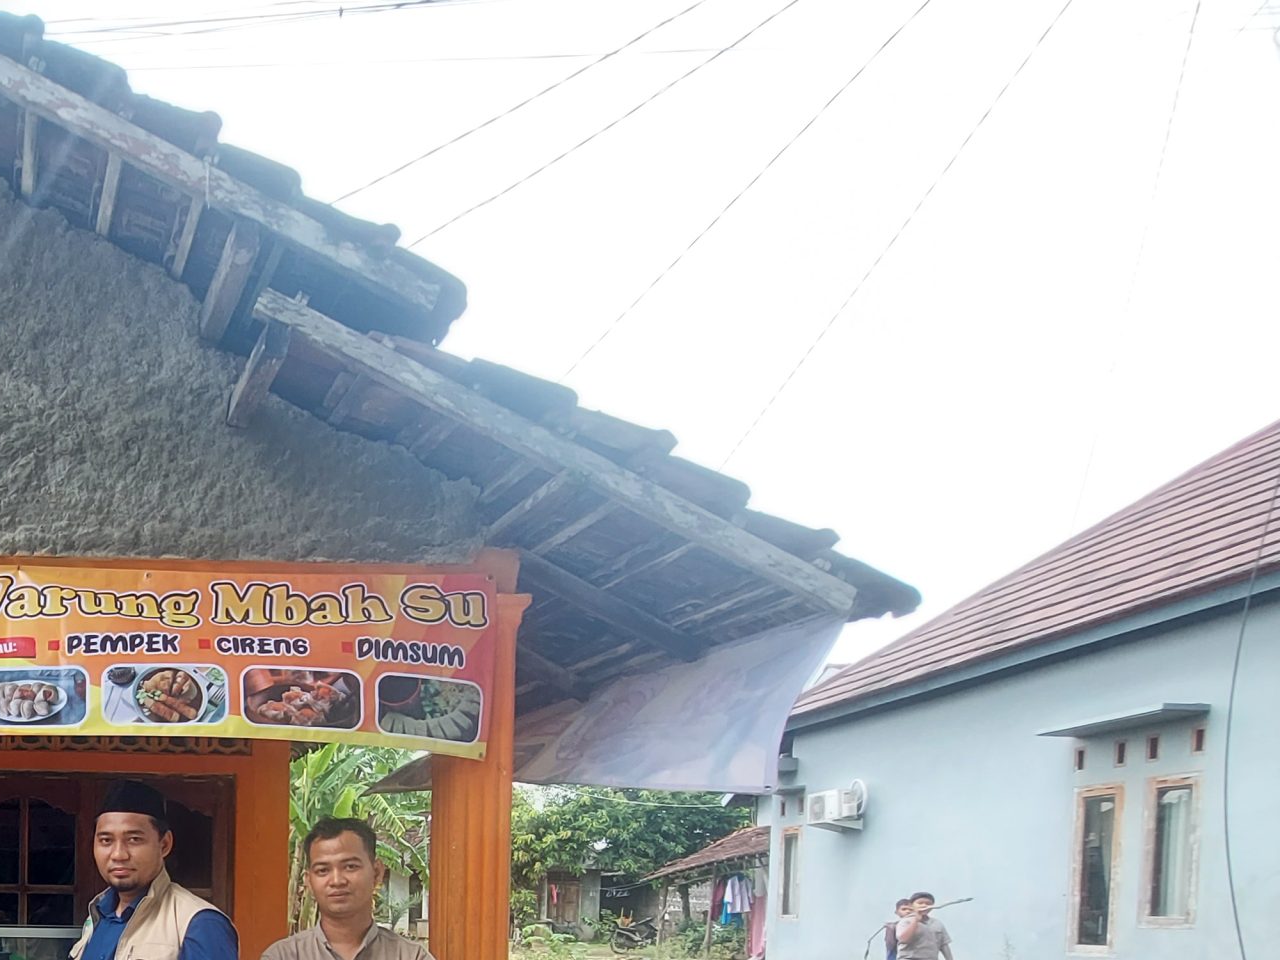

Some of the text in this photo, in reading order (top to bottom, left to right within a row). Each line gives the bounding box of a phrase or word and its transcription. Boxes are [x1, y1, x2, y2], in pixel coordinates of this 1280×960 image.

[211, 582, 393, 625] Mbah
[401, 585, 487, 627] Su
[66, 634, 179, 655] PEMPEK
[357, 638, 464, 667] DIMSUM
